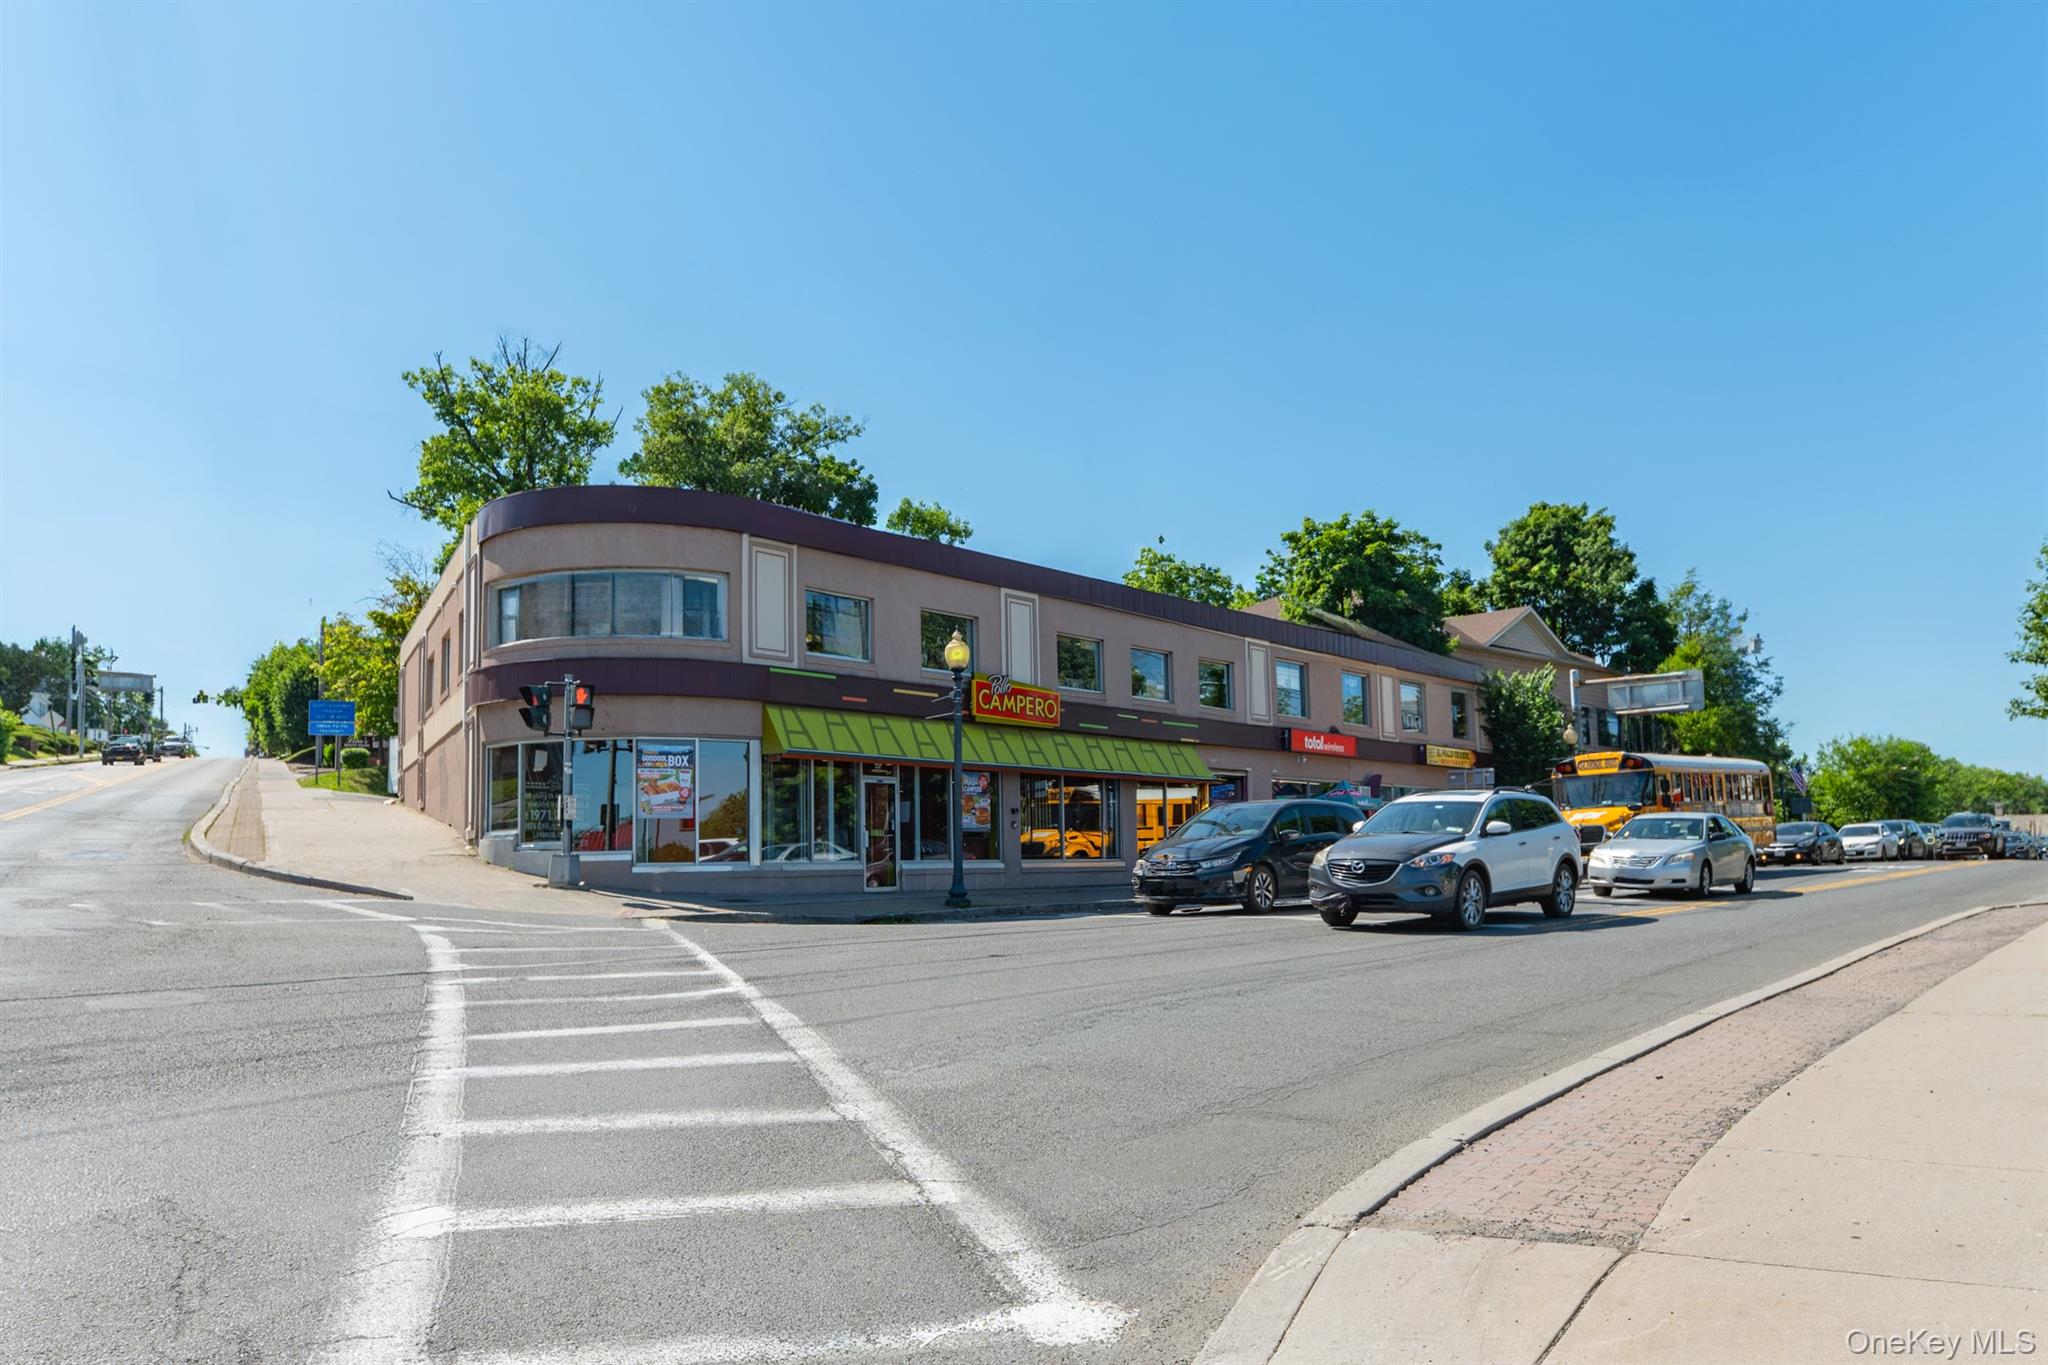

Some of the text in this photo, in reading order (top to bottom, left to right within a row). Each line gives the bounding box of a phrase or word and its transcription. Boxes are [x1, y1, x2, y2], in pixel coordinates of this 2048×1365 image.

[988, 674, 1013, 695] Pollo
[978, 689, 1058, 719] CAMPERO
[1304, 735, 1324, 751] total
[667, 754, 689, 767] BOX
